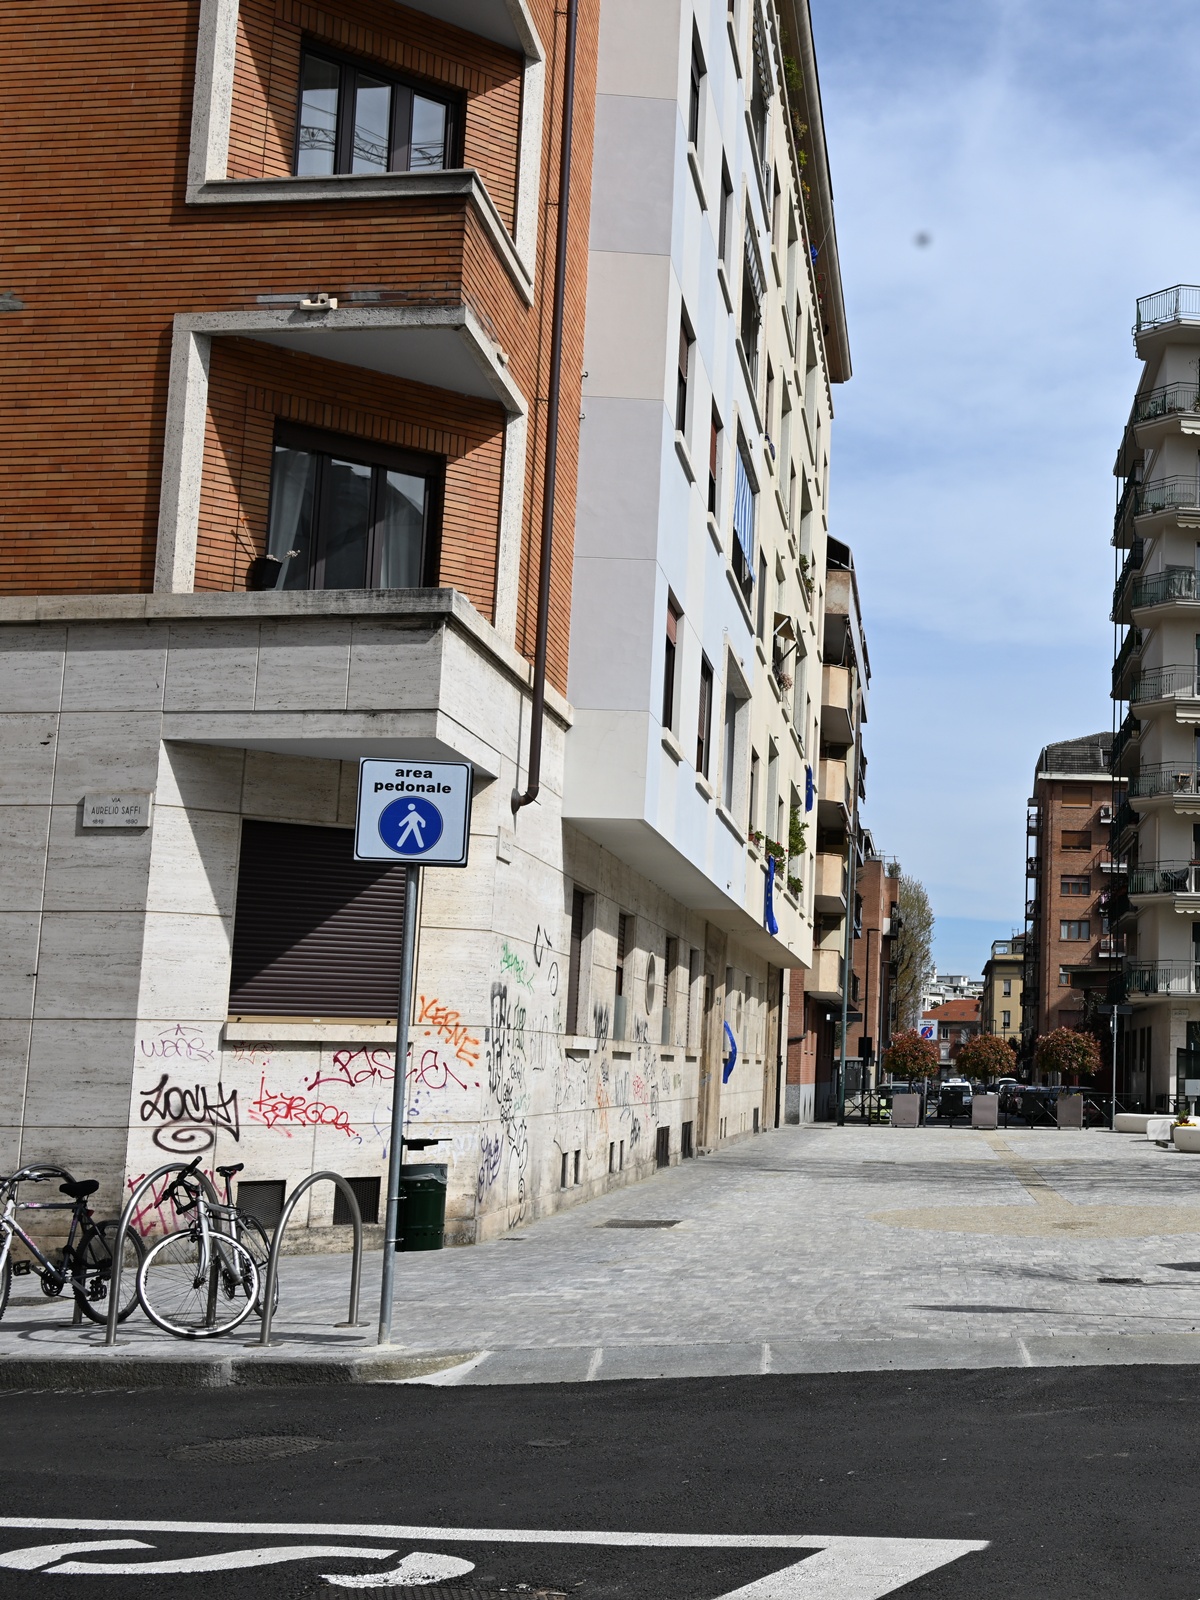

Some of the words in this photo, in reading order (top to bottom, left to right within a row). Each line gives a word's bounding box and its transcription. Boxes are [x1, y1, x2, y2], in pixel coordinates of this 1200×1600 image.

[395, 768, 433, 779] area
[374, 781, 452, 793] pedonale
[91, 806, 119, 815] AURELIO
[121, 806, 141, 815] SAFFI
